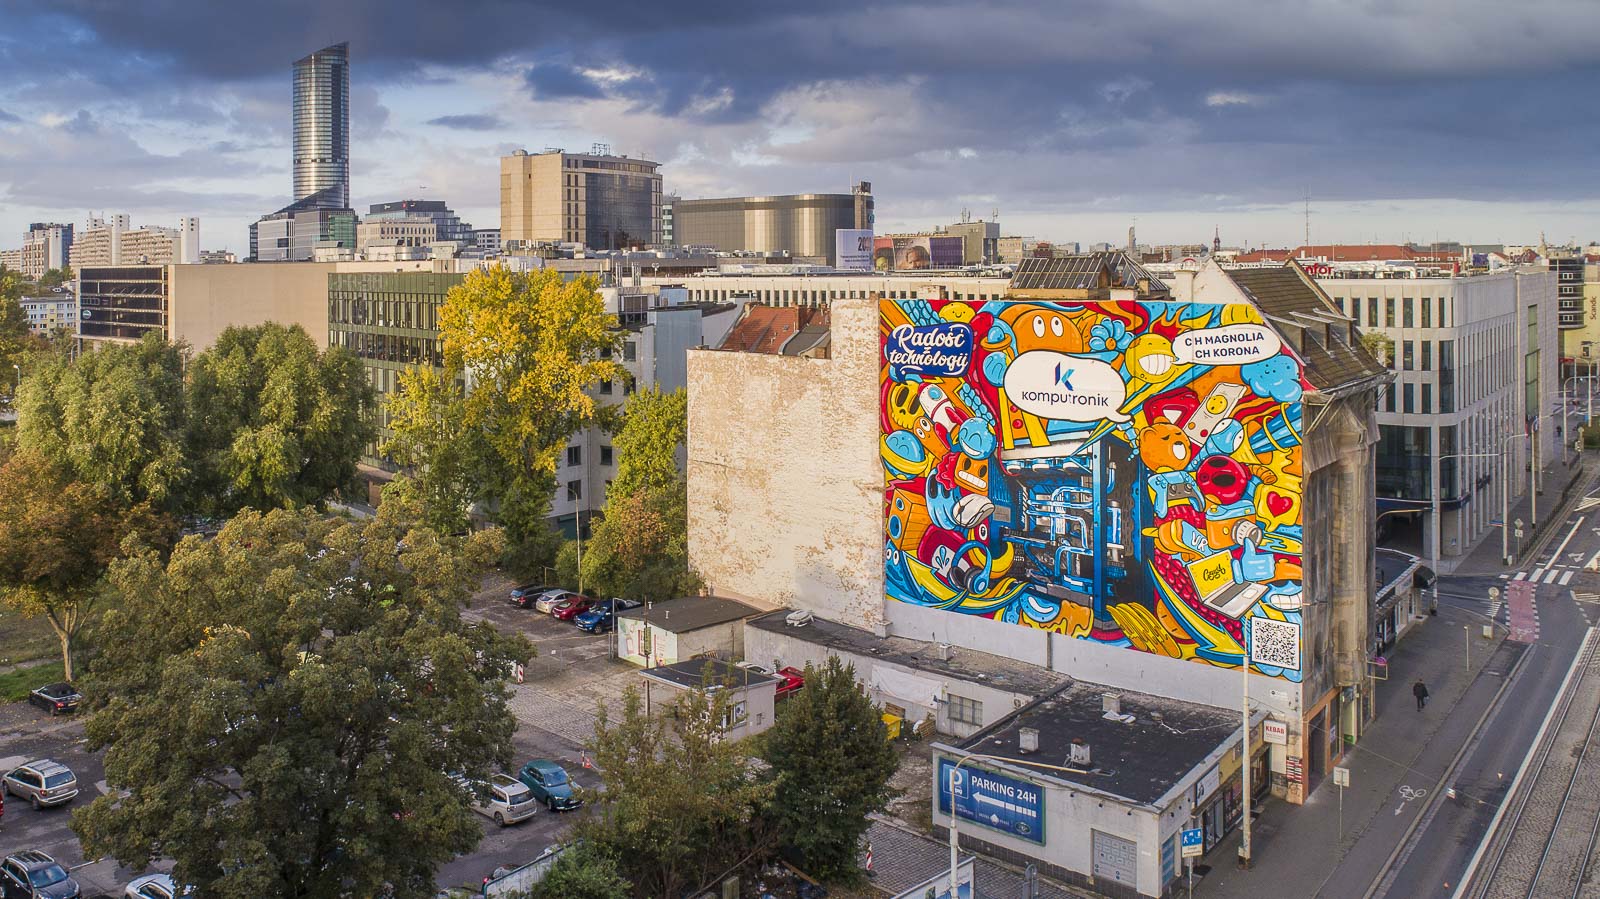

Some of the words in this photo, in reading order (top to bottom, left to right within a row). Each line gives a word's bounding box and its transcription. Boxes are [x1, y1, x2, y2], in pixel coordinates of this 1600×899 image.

[892, 324, 966, 351] Radość
[1205, 332, 1264, 345] MAGNOLIA
[1195, 349, 1211, 358] CH
[1213, 346, 1260, 357] KORONA
[889, 350, 969, 375] technologii
[1265, 725, 1285, 735] KEBAB
[971, 775, 1014, 797] PARKING
[1016, 789, 1037, 805] 24H
